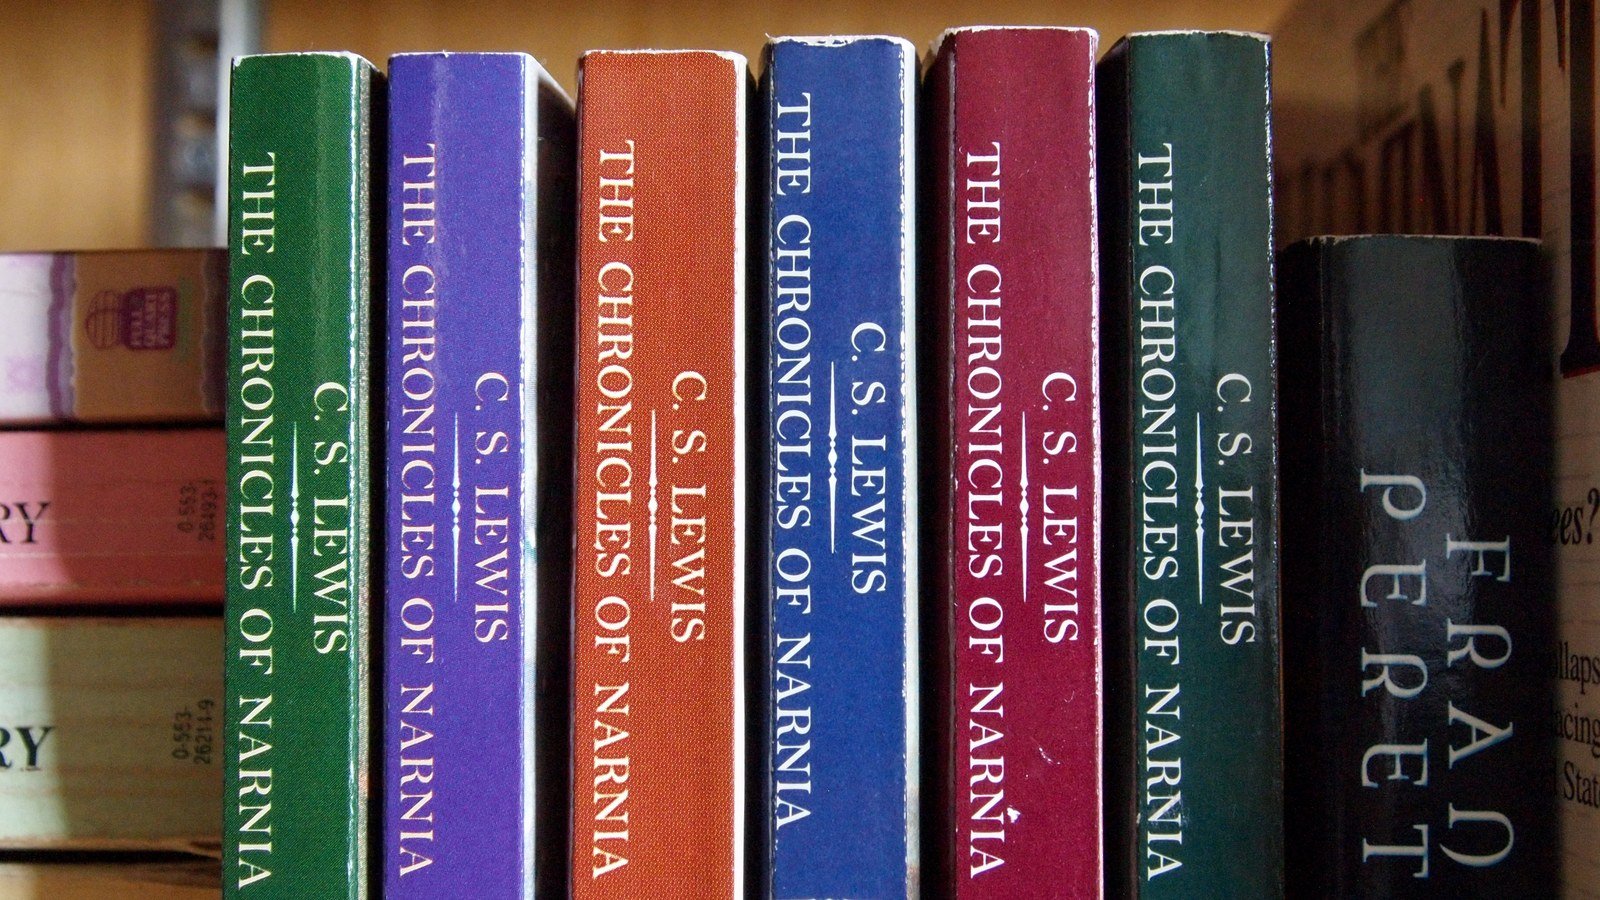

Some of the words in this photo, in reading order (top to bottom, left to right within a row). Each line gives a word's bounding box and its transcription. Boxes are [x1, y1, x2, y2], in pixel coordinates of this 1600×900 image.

[403, 143, 437, 246] THE
[598, 139, 636, 243] THE
[775, 92, 812, 196] THE
[966, 141, 1001, 245] THE
[1138, 142, 1174, 246] THE
[242, 151, 276, 255] THE
[474, 372, 509, 411] C.
[671, 370, 708, 411] C.
[774, 214, 813, 530] CHRONICLES
[851, 321, 886, 362] C.
[1042, 371, 1077, 411] C.
[1216, 372, 1252, 412] C.
[239, 274, 275, 590] CHRONICLES
[313, 381, 349, 421] C.
[401, 264, 436, 579] CHRONICLES
[474, 431, 509, 465] S.
[595, 261, 635, 578] CHRONICLES
[671, 429, 708, 464] S.
[851, 381, 886, 415] S.
[967, 263, 1003, 579] CHRONICLES
[1042, 431, 1077, 465] S.
[1139, 265, 1179, 581] CHRONICLES
[1216, 432, 1252, 466] S.
[313, 441, 349, 475] S.
[474, 486, 509, 643] LEWIS
[669, 484, 707, 643] LEWIS
[851, 434, 887, 594] LEWIS
[1042, 484, 1079, 644] LEWIS
[1218, 485, 1256, 646] LEWIS
[313, 495, 349, 654] LEWIS
[774, 547, 812, 614] OF
[239, 608, 273, 676] OF
[400, 597, 435, 664] OF
[594, 595, 631, 664] OF
[968, 596, 1004, 664] OF
[1143, 598, 1180, 666] OF
[1360, 467, 1429, 878] PERET
[399, 683, 434, 877] NARNIA
[592, 681, 631, 880] NARNIA
[773, 632, 812, 831] NARNIA
[969, 682, 1005, 879] NARNIA
[1145, 683, 1183, 881] NARNIA
[238, 694, 273, 890] NARNIA
[1563, 760, 1600, 809] Stat
